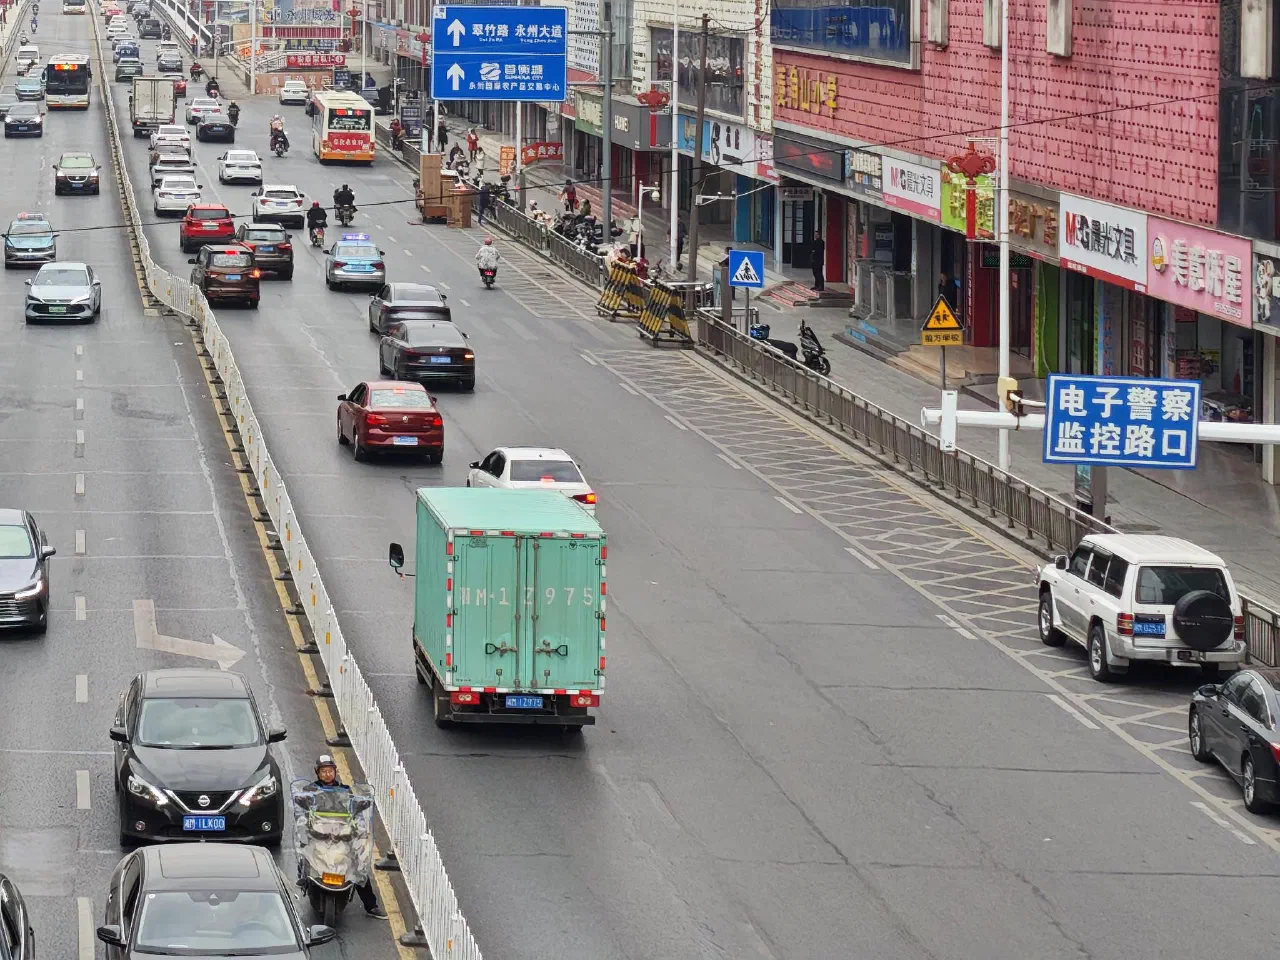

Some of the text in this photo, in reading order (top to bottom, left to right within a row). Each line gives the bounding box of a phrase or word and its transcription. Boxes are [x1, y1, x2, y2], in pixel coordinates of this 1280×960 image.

[472, 23, 563, 38] 翠竹路 永州大道
[1171, 238, 1243, 304] 美意饼屋
[925, 333, 961, 343] 前方学校
[1058, 384, 1192, 422] 电子警察
[1055, 422, 1188, 458] 监控路口
